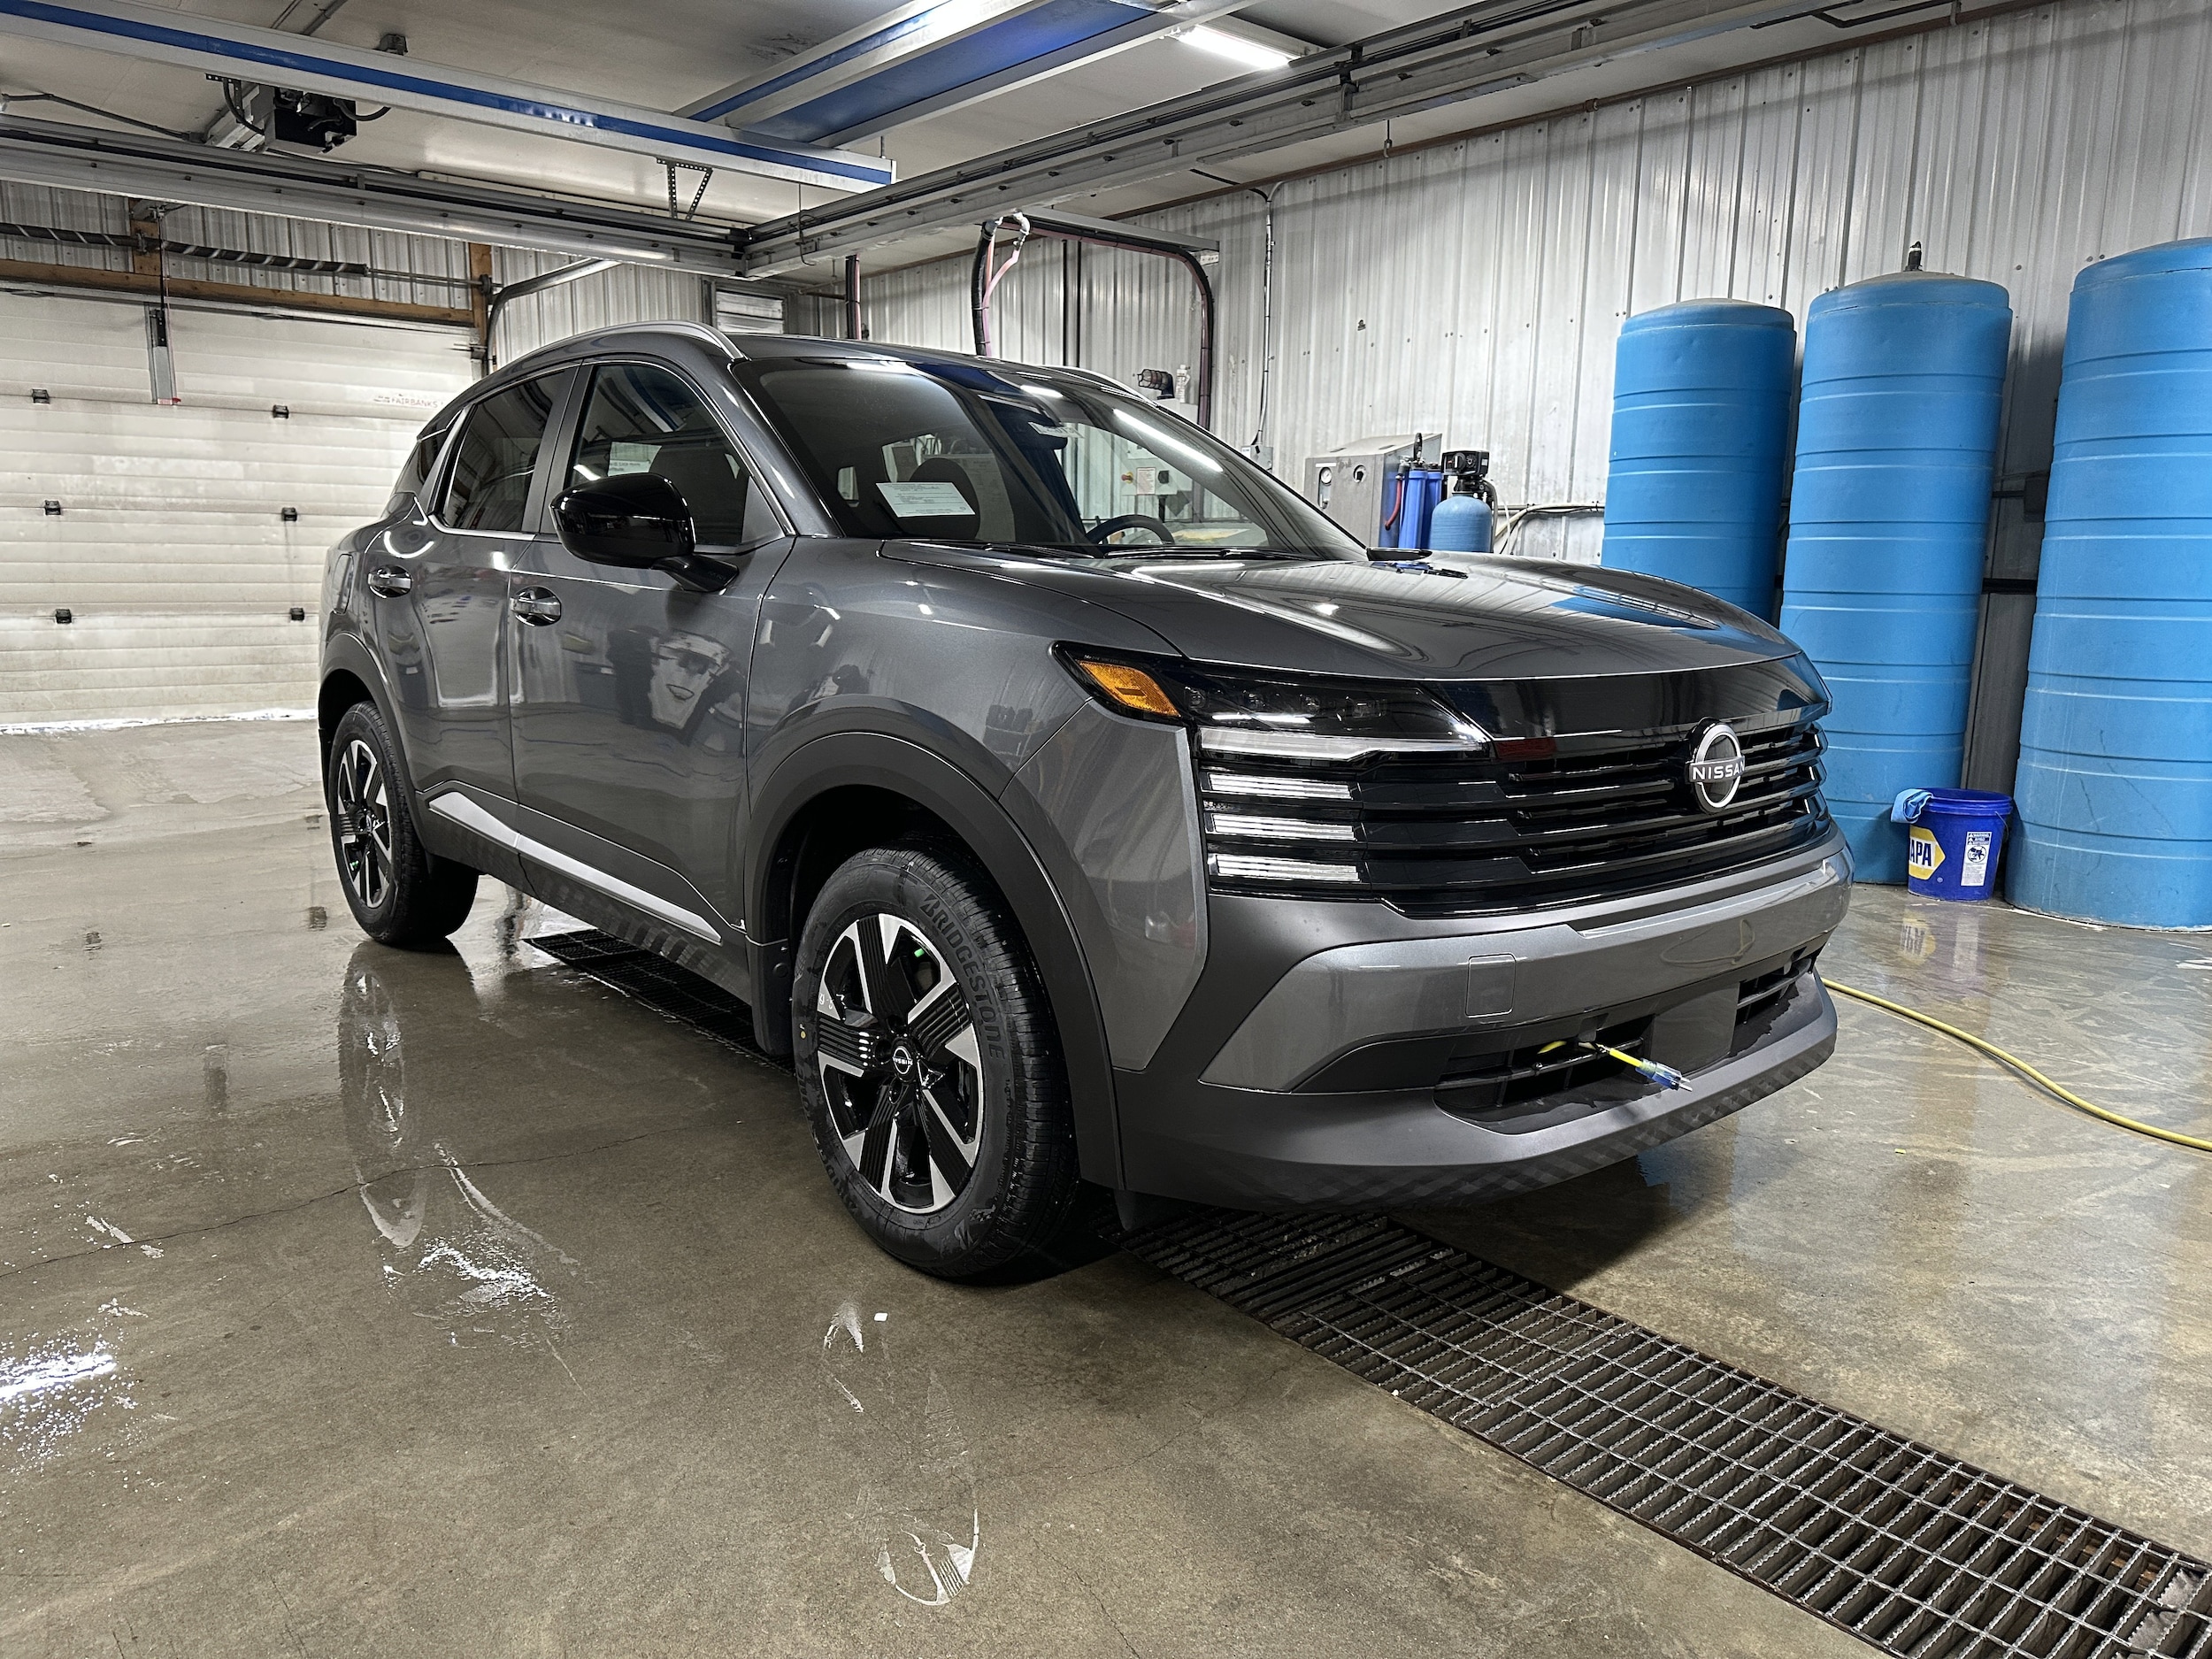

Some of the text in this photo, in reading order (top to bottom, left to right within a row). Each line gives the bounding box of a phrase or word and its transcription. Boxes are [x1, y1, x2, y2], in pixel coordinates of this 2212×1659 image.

[391, 397, 438, 408] FAIRBANKS
[1692, 760, 1745, 780] NISSAN
[919, 893, 1006, 1061] BRIDGESTONE
